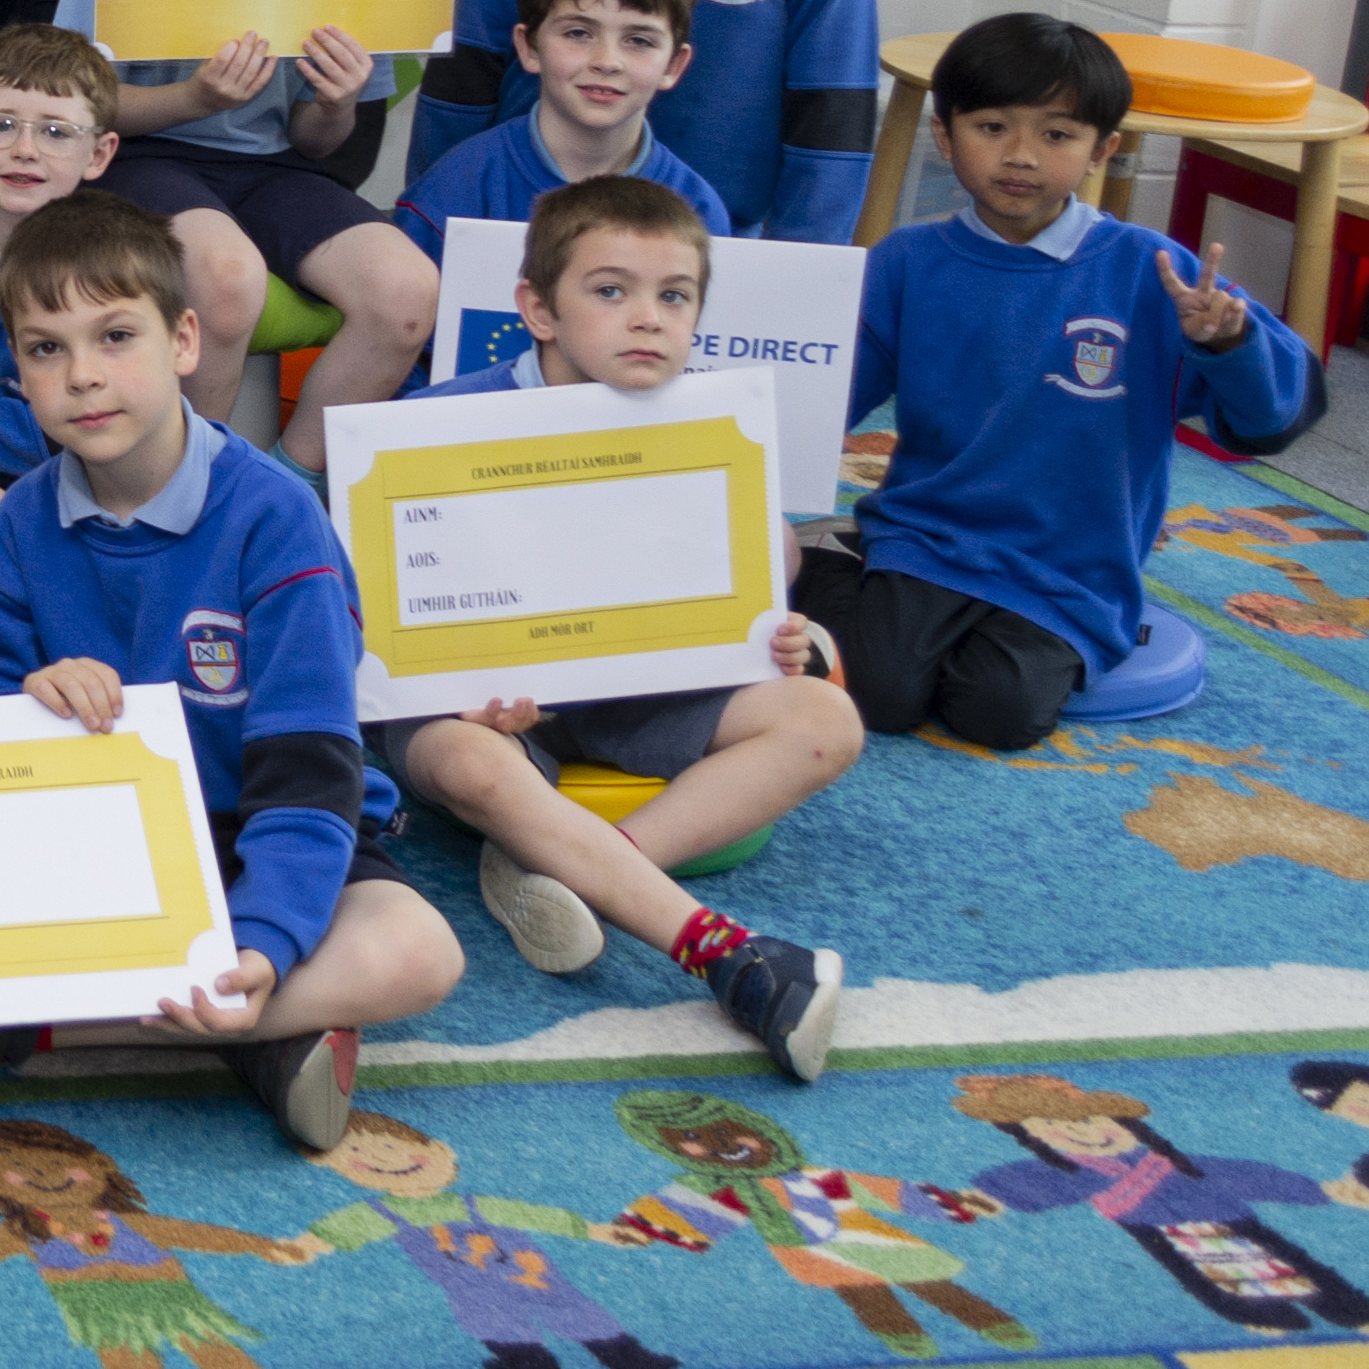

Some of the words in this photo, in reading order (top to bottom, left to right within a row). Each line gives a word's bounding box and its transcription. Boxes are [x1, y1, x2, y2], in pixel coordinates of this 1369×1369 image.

[727, 335, 839, 365] DIRECT
[471, 462, 534, 480] CRANNCHUR
[580, 451, 643, 470] SAMHRAIDH
[403, 506, 443, 525] AINM:
[406, 551, 441, 570] AOIS:
[408, 594, 457, 615] UIMHIR
[459, 589, 523, 610] GUTHÁIN:
[573, 620, 594, 636] ORT
